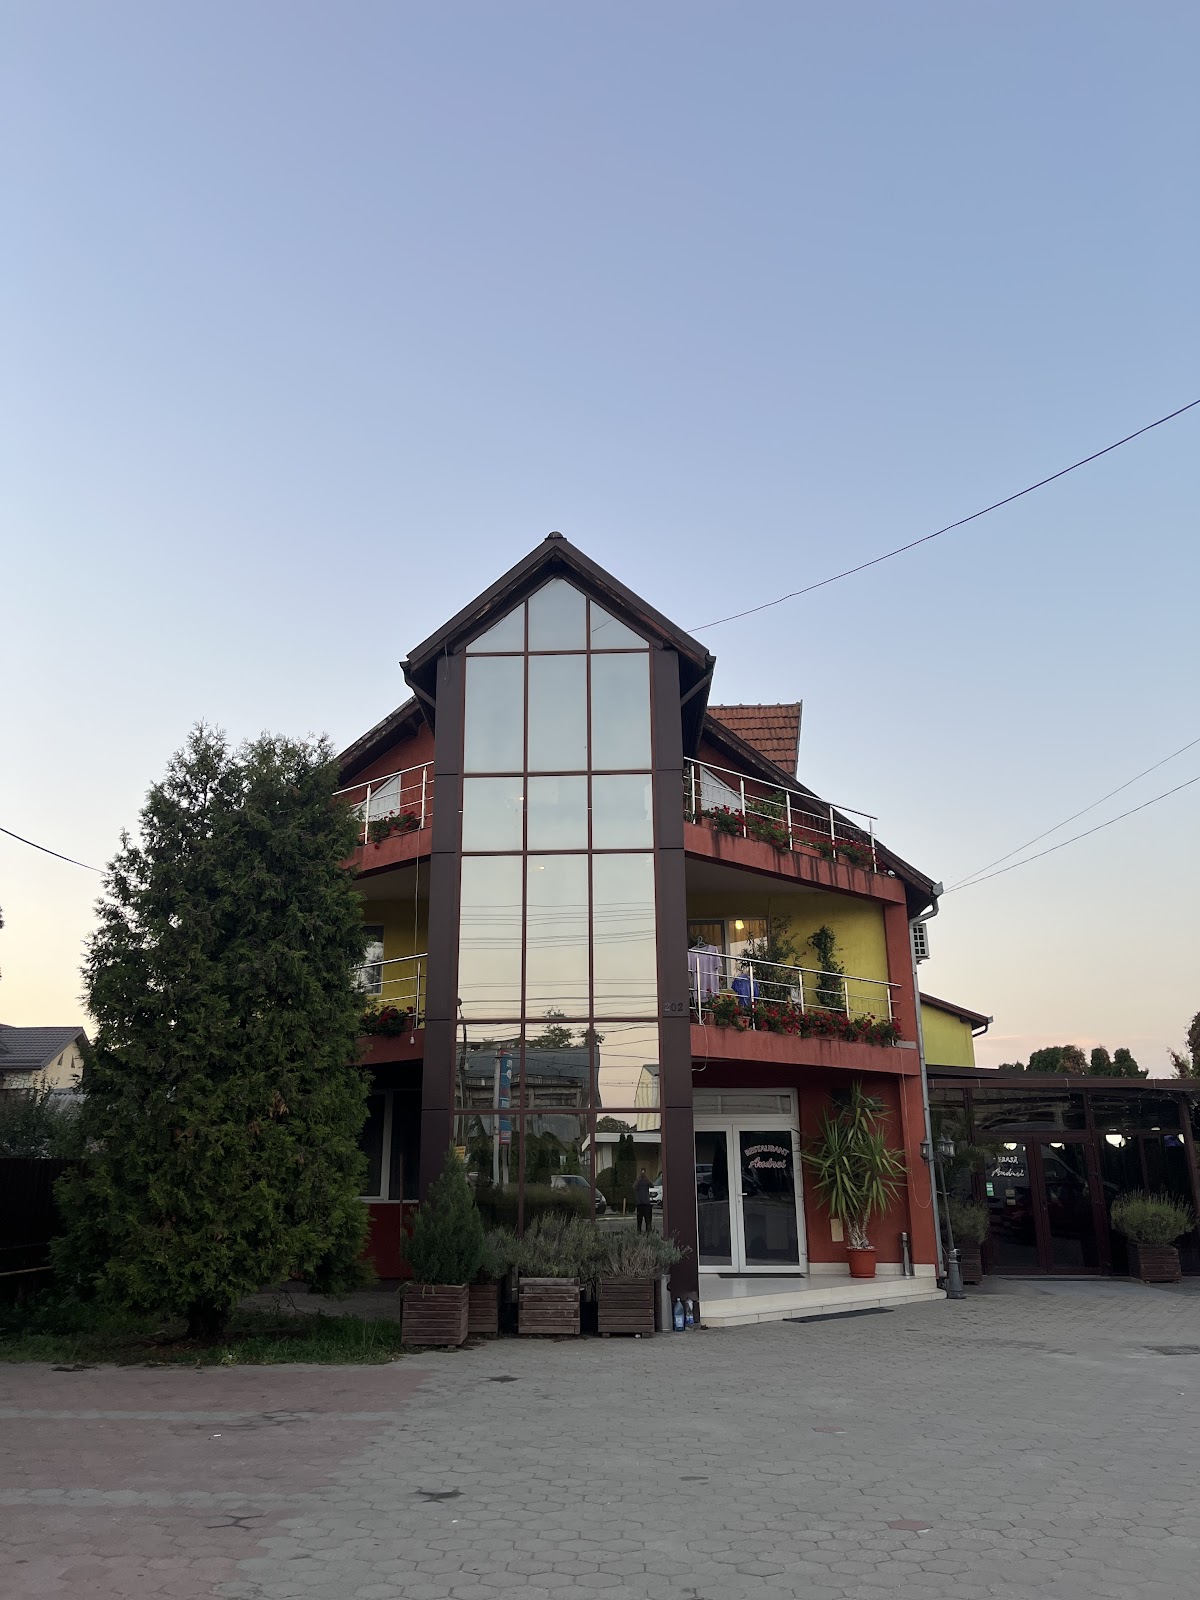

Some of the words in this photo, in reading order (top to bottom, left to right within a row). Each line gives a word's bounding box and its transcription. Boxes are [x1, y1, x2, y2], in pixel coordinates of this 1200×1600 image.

[664, 1002, 684, 1012] 202
[744, 1144, 790, 1157] RESTAURANT
[748, 1156, 787, 1169] Andrei
